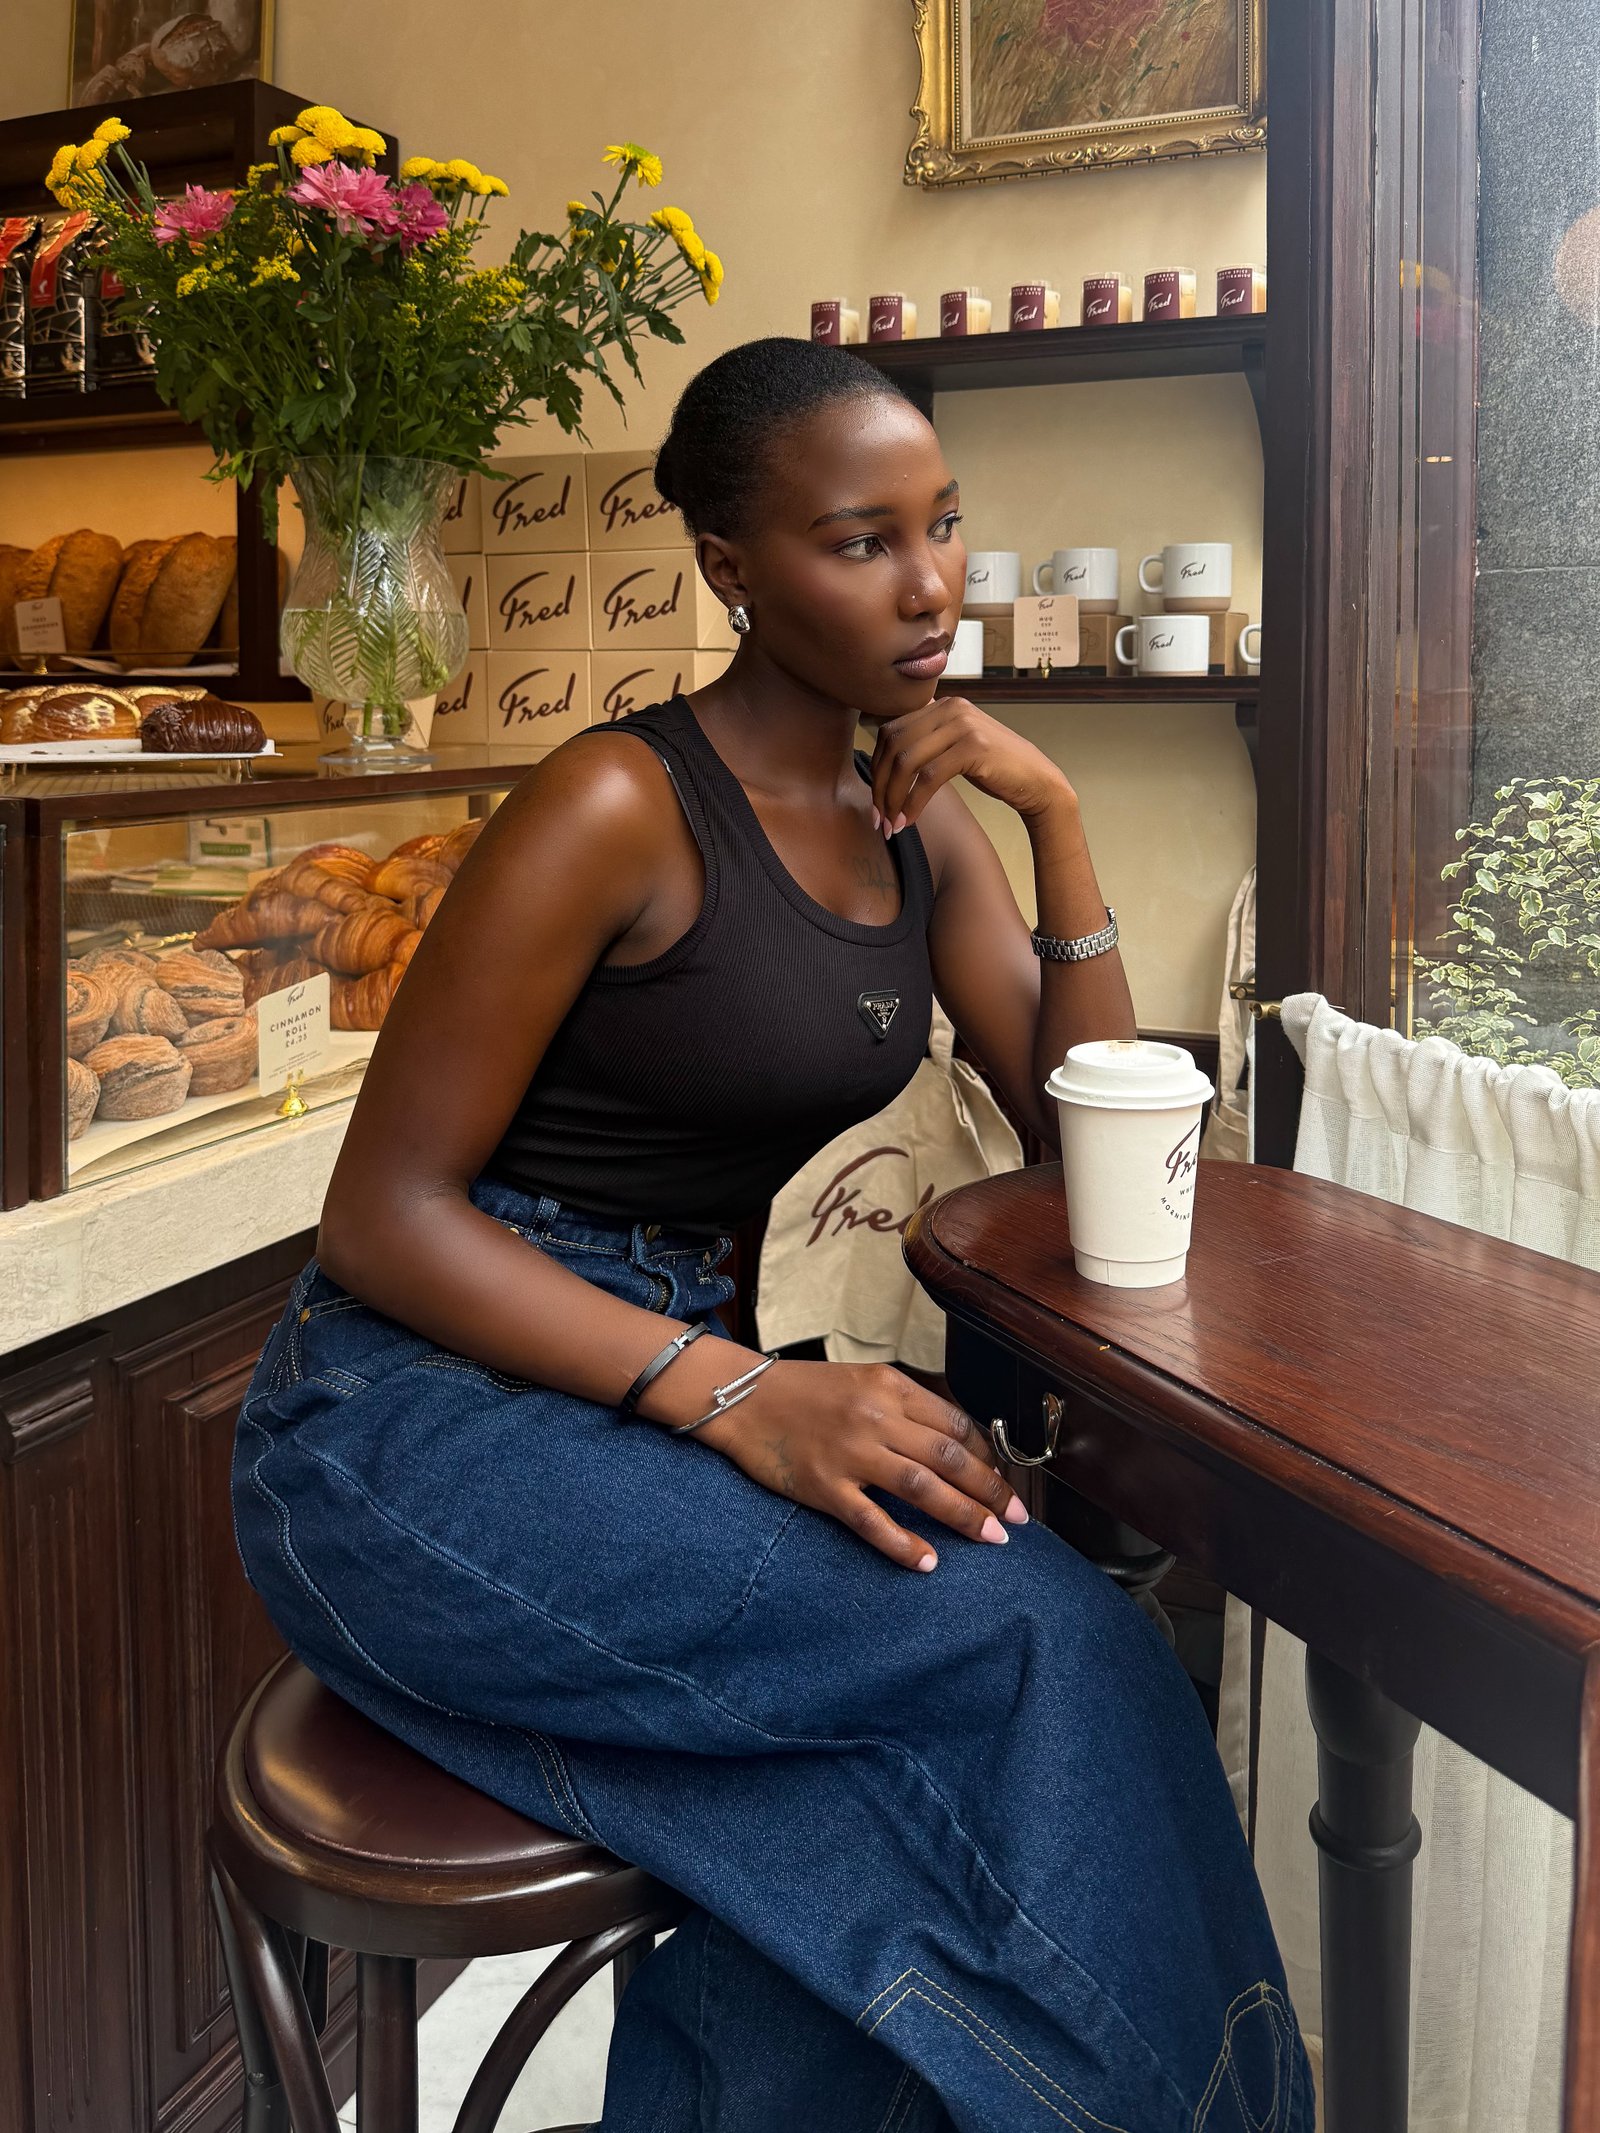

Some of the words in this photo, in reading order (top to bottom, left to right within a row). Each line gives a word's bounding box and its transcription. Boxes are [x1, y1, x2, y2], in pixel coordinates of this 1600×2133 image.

[1148, 292, 1172, 312] Fred
[1221, 289, 1245, 309] Fred
[1014, 306, 1038, 324] Fred
[1087, 299, 1111, 318] Fred
[872, 316, 895, 333] Fred
[942, 313, 960, 328] Fred
[493, 472, 571, 536] Fred
[967, 570, 990, 586] Fred
[1064, 566, 1087, 584] Fred
[1180, 562, 1206, 580] Fred
[500, 572, 574, 632] Fred
[604, 568, 682, 632] Fred
[1038, 598, 1054, 610] Fred
[1149, 634, 1174, 650] Fred
[434, 672, 473, 716] ed
[499, 668, 576, 728] Fred
[288, 985, 305, 1006] Fred
[872, 1000, 895, 1010] PRADA
[270, 1004, 322, 1032] CINNAMON
[286, 1023, 307, 1038] ROLL
